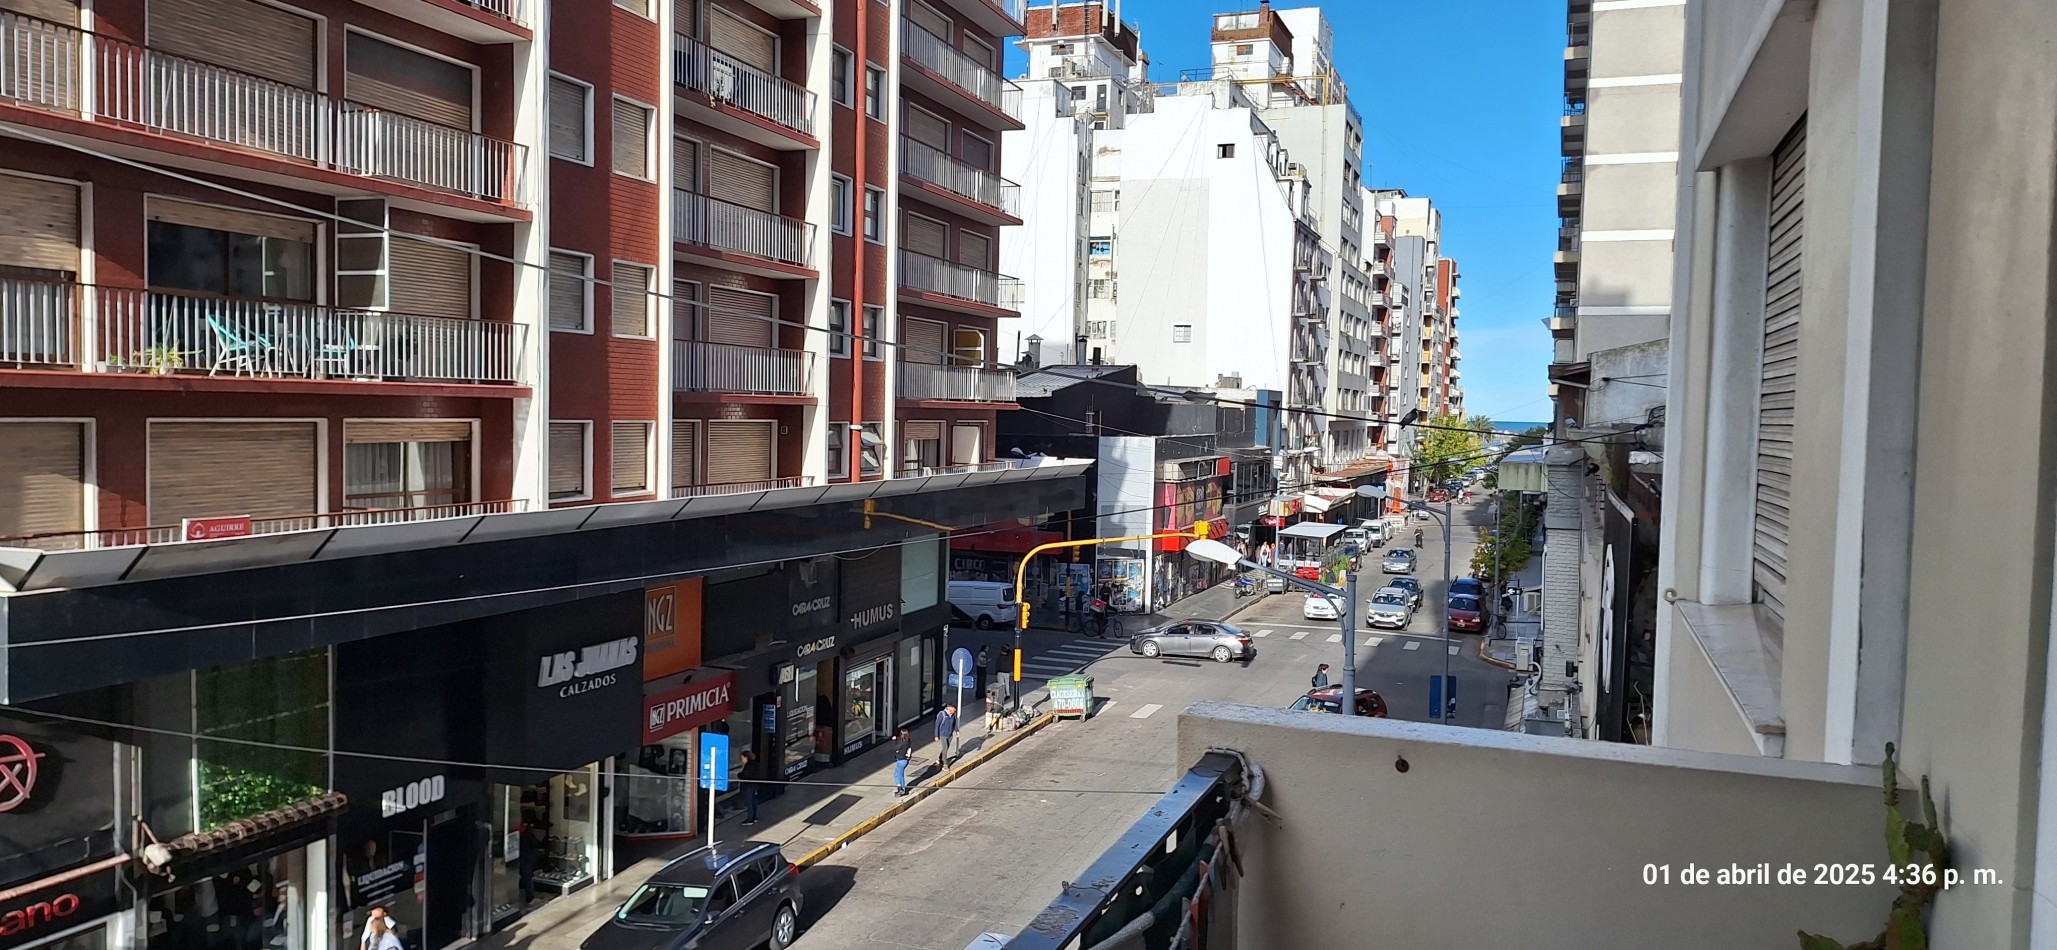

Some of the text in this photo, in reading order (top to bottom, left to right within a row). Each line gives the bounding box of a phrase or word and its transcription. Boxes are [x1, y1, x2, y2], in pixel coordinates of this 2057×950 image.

[208, 523, 245, 533] AGUIRRE
[647, 594, 673, 635] NGZ
[853, 603, 894, 629] HUMUS
[538, 651, 576, 687] LAS
[560, 673, 617, 698] CALZADOS
[651, 706, 664, 727] NGZ
[843, 740, 863, 755] HUMUS
[381, 774, 445, 819] BLOOD
